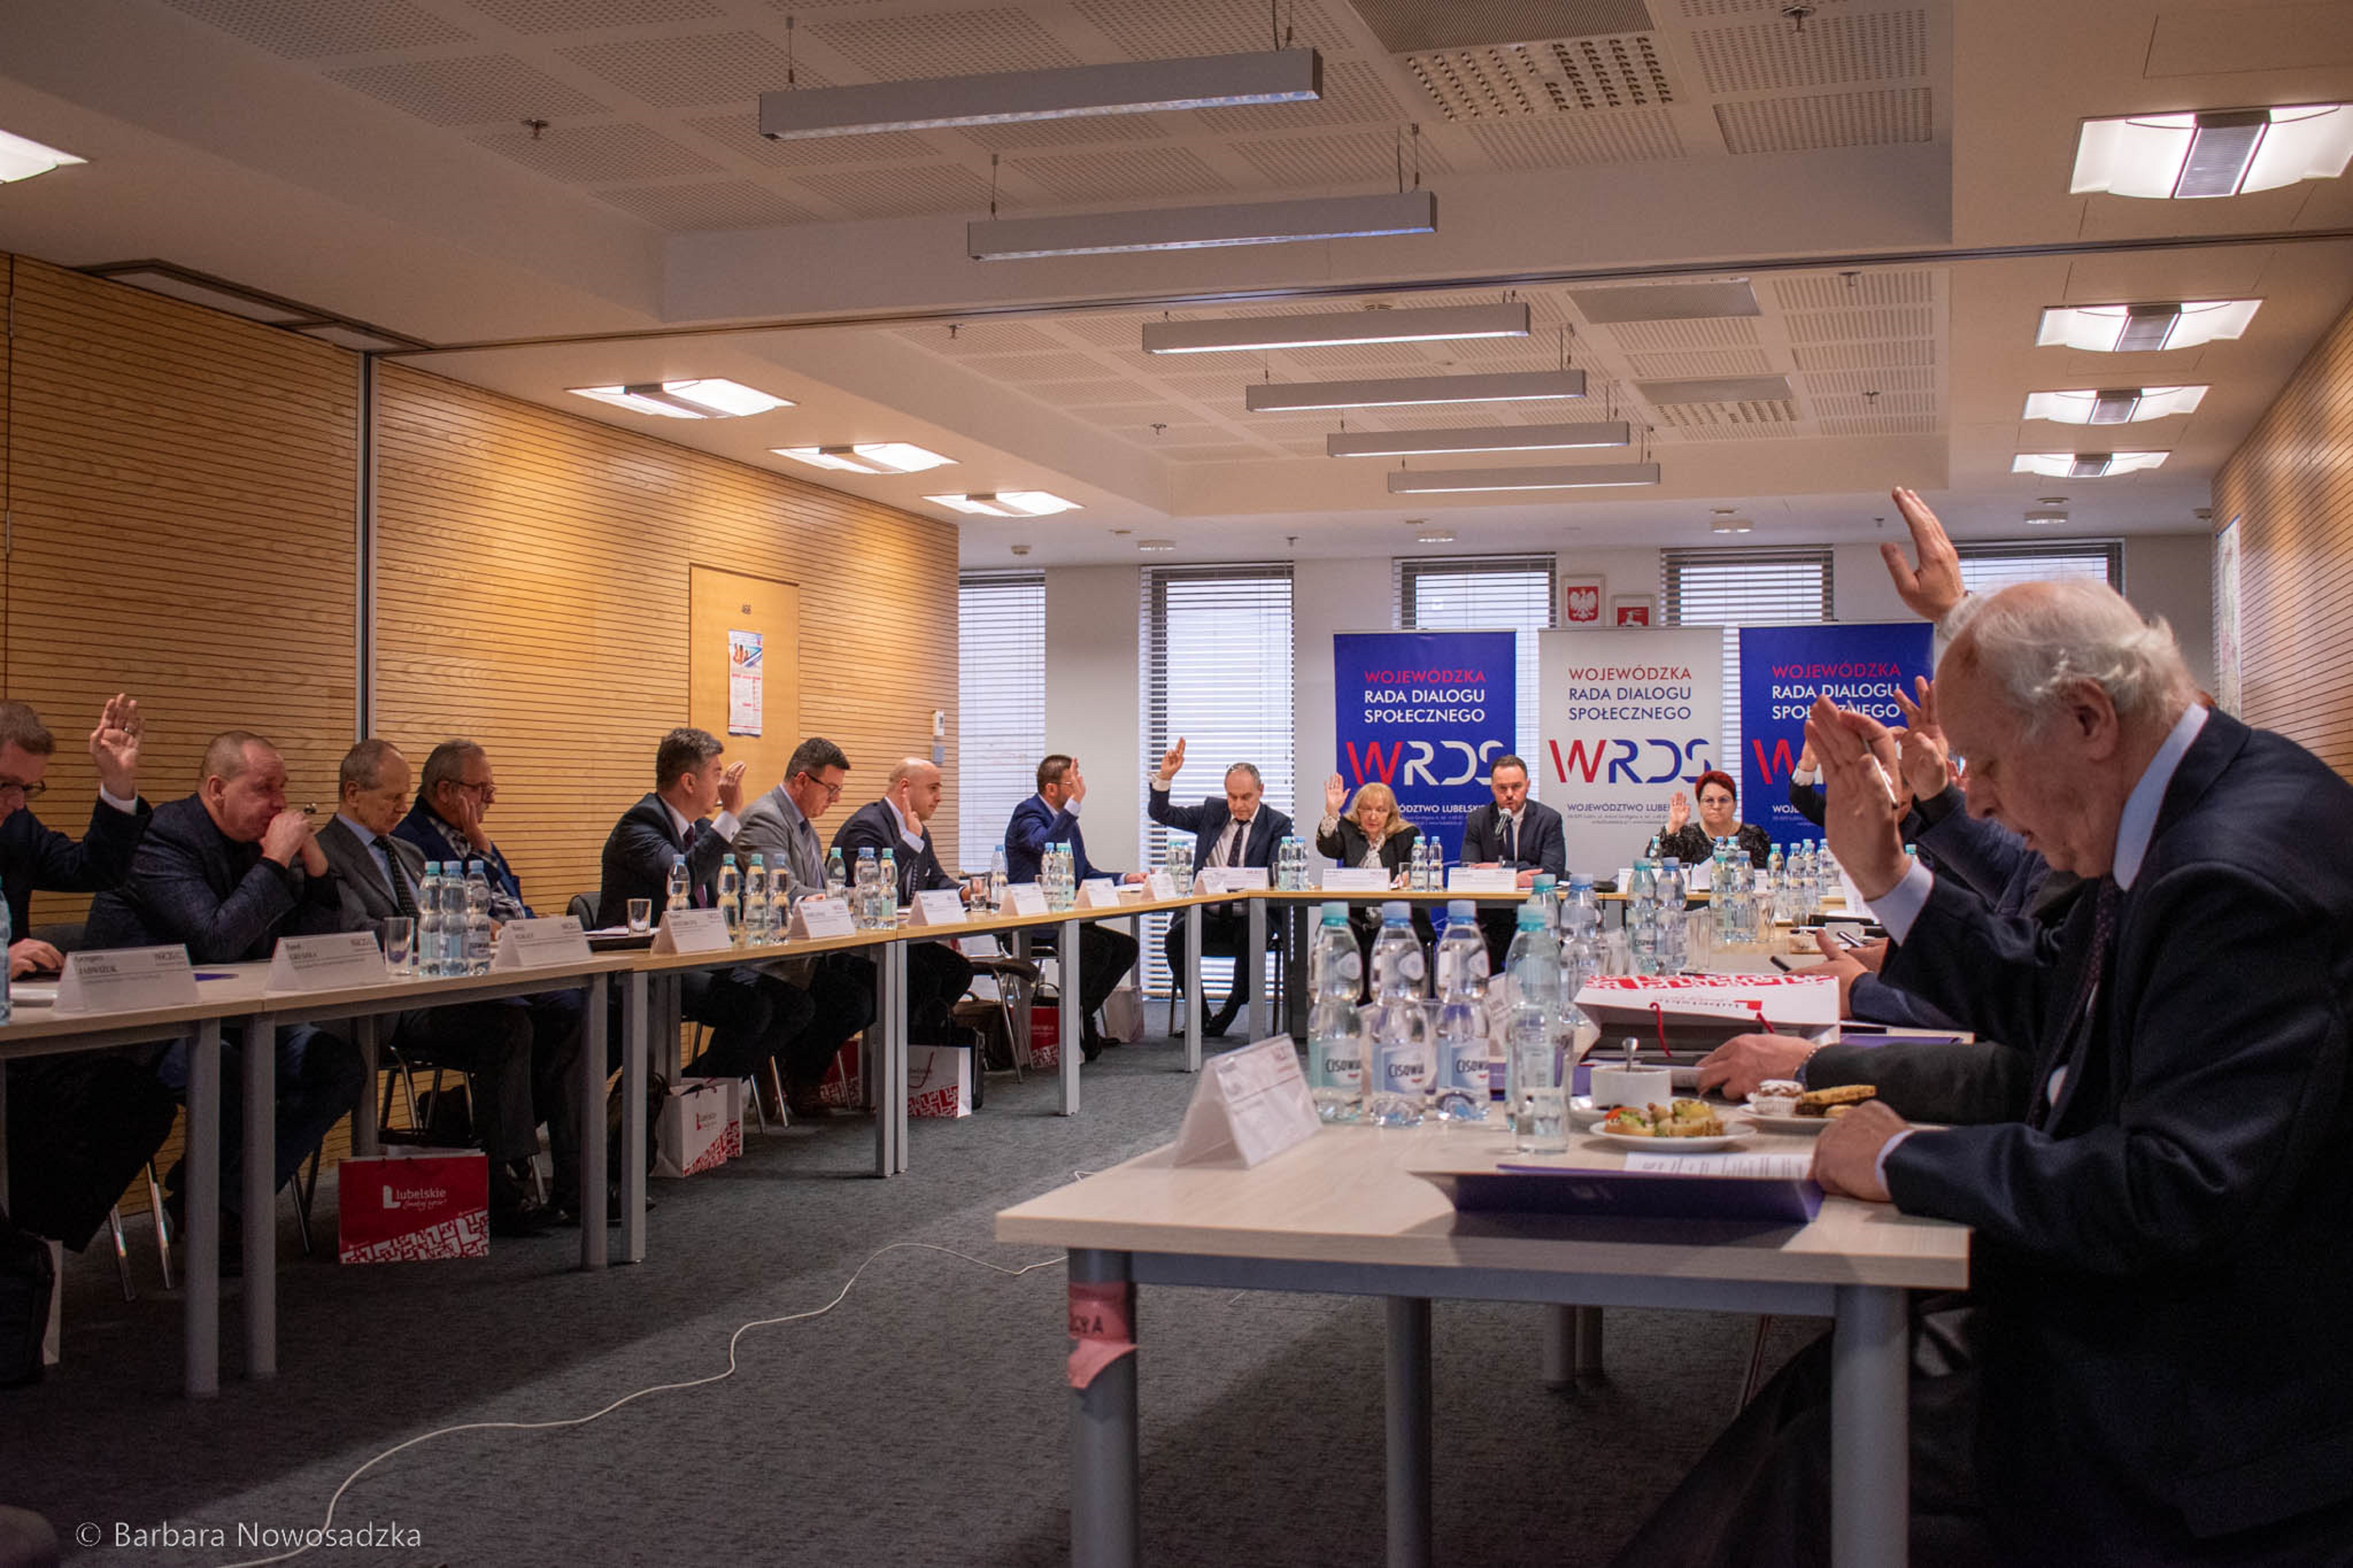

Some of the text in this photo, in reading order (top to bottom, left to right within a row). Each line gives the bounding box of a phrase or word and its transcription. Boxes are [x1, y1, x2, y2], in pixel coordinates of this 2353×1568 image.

[1364, 668, 1486, 683] WOJEWÓDZKA
[1569, 665, 1691, 680] WOJEWÓDZKA
[1771, 660, 1901, 679] WOJEWÓDZKA
[1365, 689, 1485, 703] RADA DIALOGU
[1569, 687, 1691, 700] RADA DIALOGU
[1772, 683, 1900, 699] RADA DIALOGU
[1364, 709, 1485, 723] SPOŁECZNEGO
[1569, 707, 1691, 720] SPOŁECZNEGO
[1345, 740, 1504, 786] WRDS
[1548, 739, 1712, 783] WRDS
[1397, 803, 1440, 813] ÓDZTWO
[1568, 803, 1643, 812] WOJEWÓDZTWO
